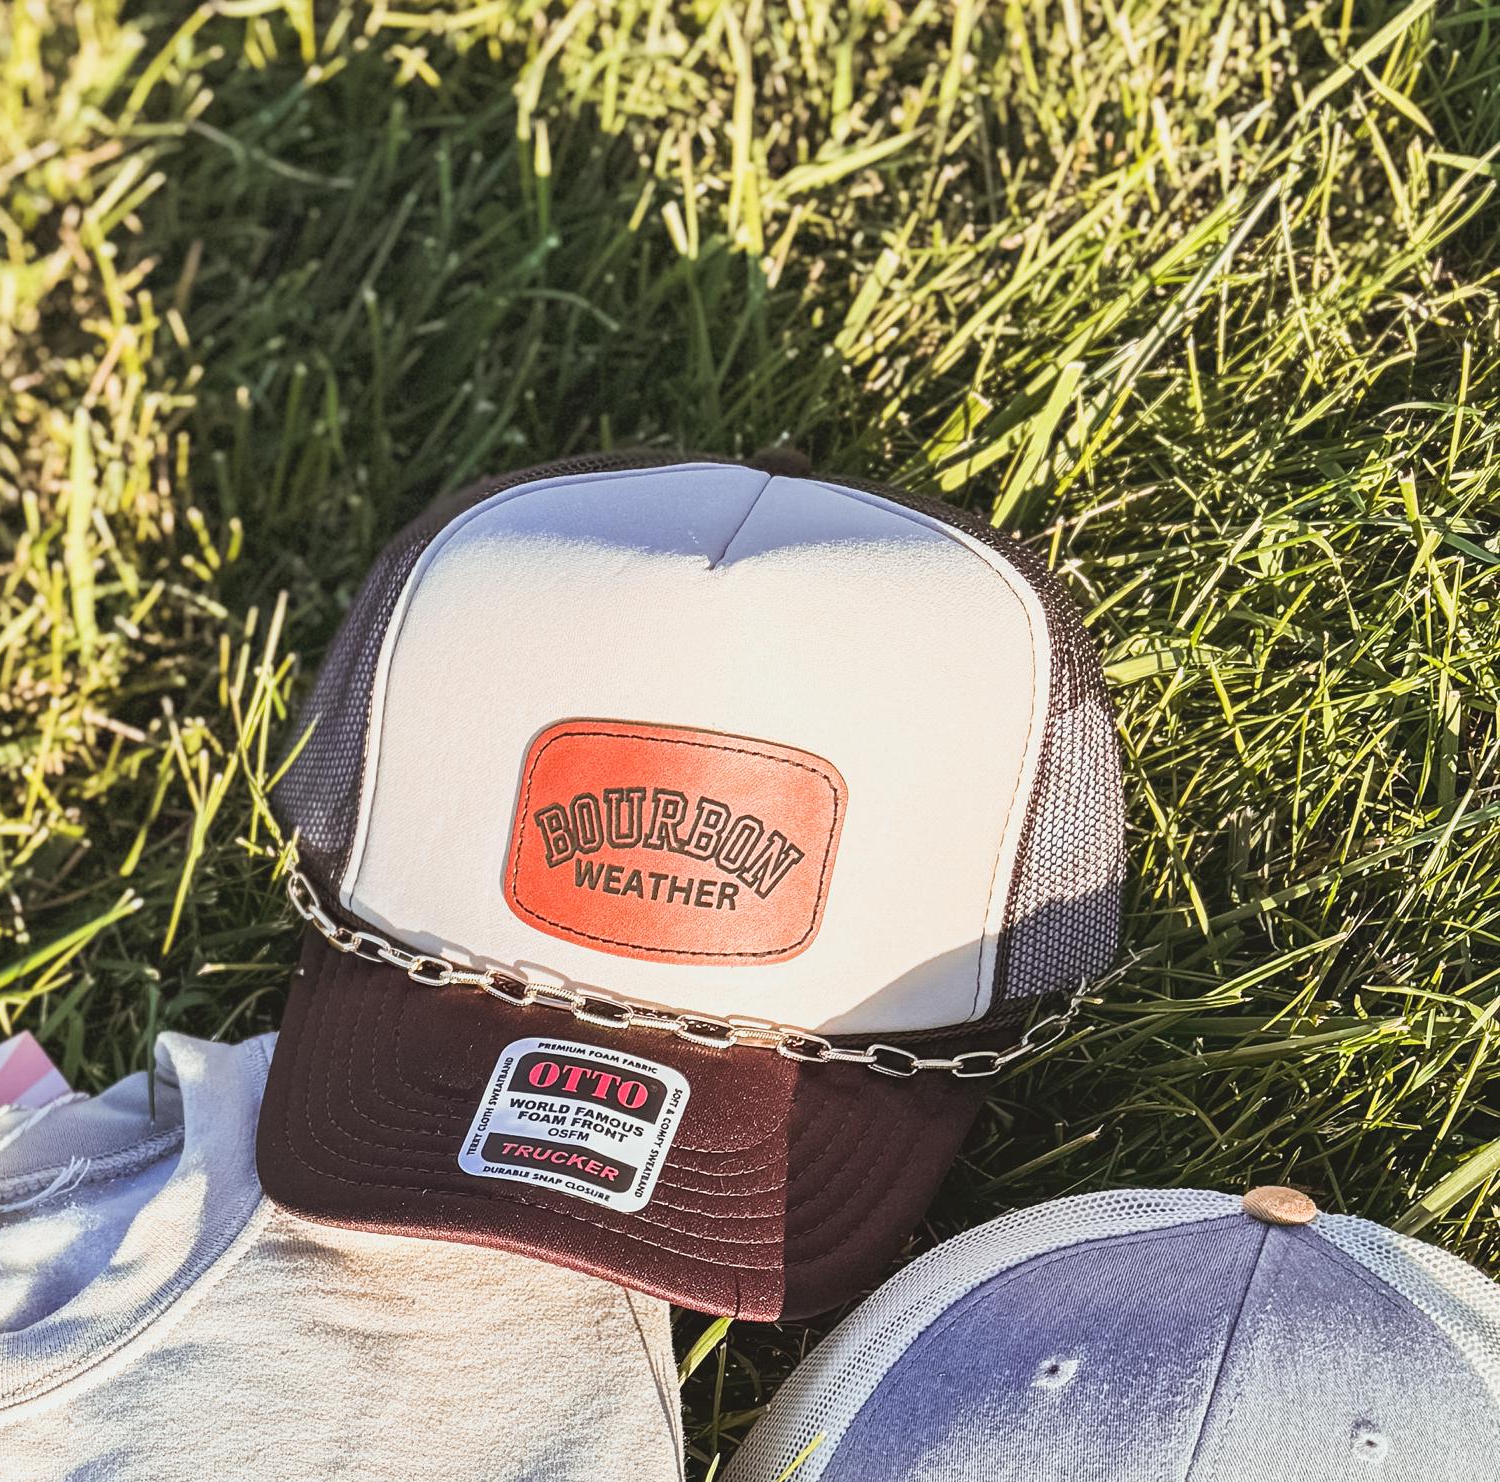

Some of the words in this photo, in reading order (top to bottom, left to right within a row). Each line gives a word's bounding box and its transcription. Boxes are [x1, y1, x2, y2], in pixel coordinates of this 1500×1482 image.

[533, 786, 805, 899] BOURBON
[574, 858, 740, 911] WEATHER
[537, 1042, 586, 1056] PREMIUM
[588, 1050, 620, 1063] FOAM
[622, 1058, 659, 1074] FABRIC
[477, 1107, 494, 1131] CLOTH
[488, 1056, 514, 1106] SWEATBAND
[528, 1061, 648, 1109] OTTO
[669, 1088, 683, 1108] SOFT
[509, 1098, 571, 1114] WORLD
[574, 1106, 645, 1137] FAMOUS
[517, 1111, 567, 1126] FOAM
[571, 1117, 629, 1143] FRONT
[547, 1127, 590, 1142] OSFM
[654, 1118, 671, 1148] COMFY
[501, 1142, 620, 1182] TRUCKER
[634, 1149, 659, 1198] SWEATBAND
[482, 1165, 530, 1179] DURABLE
[532, 1173, 562, 1186] SNAP
[564, 1181, 611, 1202] CLOSURE
